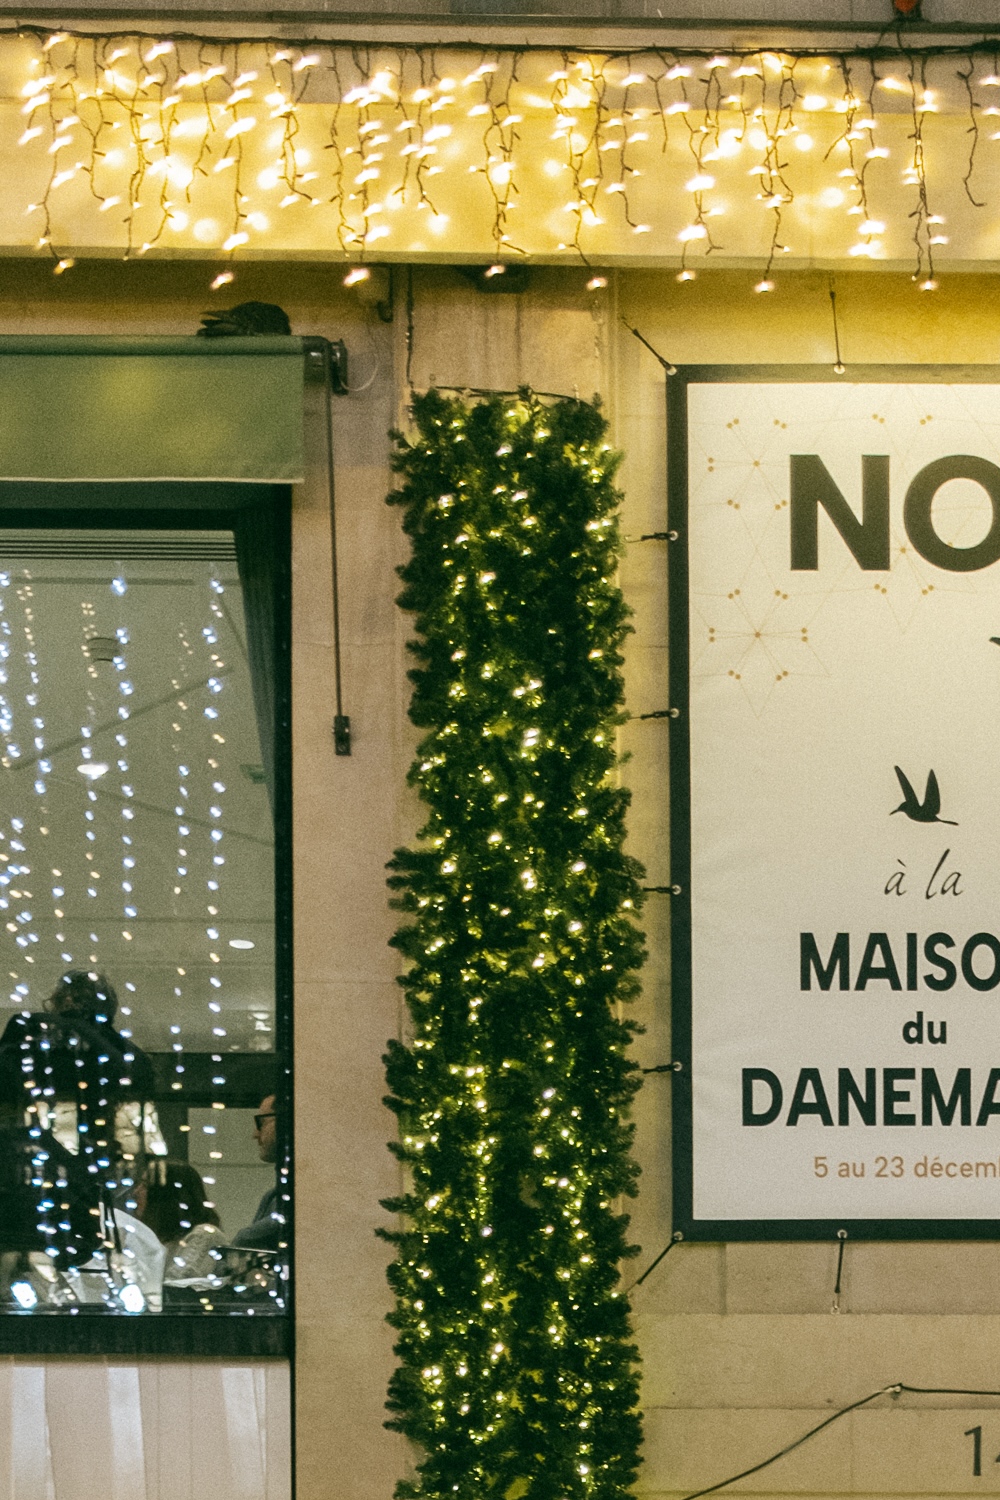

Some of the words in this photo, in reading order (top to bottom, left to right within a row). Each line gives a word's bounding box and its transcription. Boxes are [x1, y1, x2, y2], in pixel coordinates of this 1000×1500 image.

[884, 859, 907, 897] à
[925, 848, 963, 900] la
[902, 1011, 947, 1044] du
[813, 1157, 828, 1178] 5
[837, 1162, 865, 1178] au
[874, 1157, 904, 1178] 23
